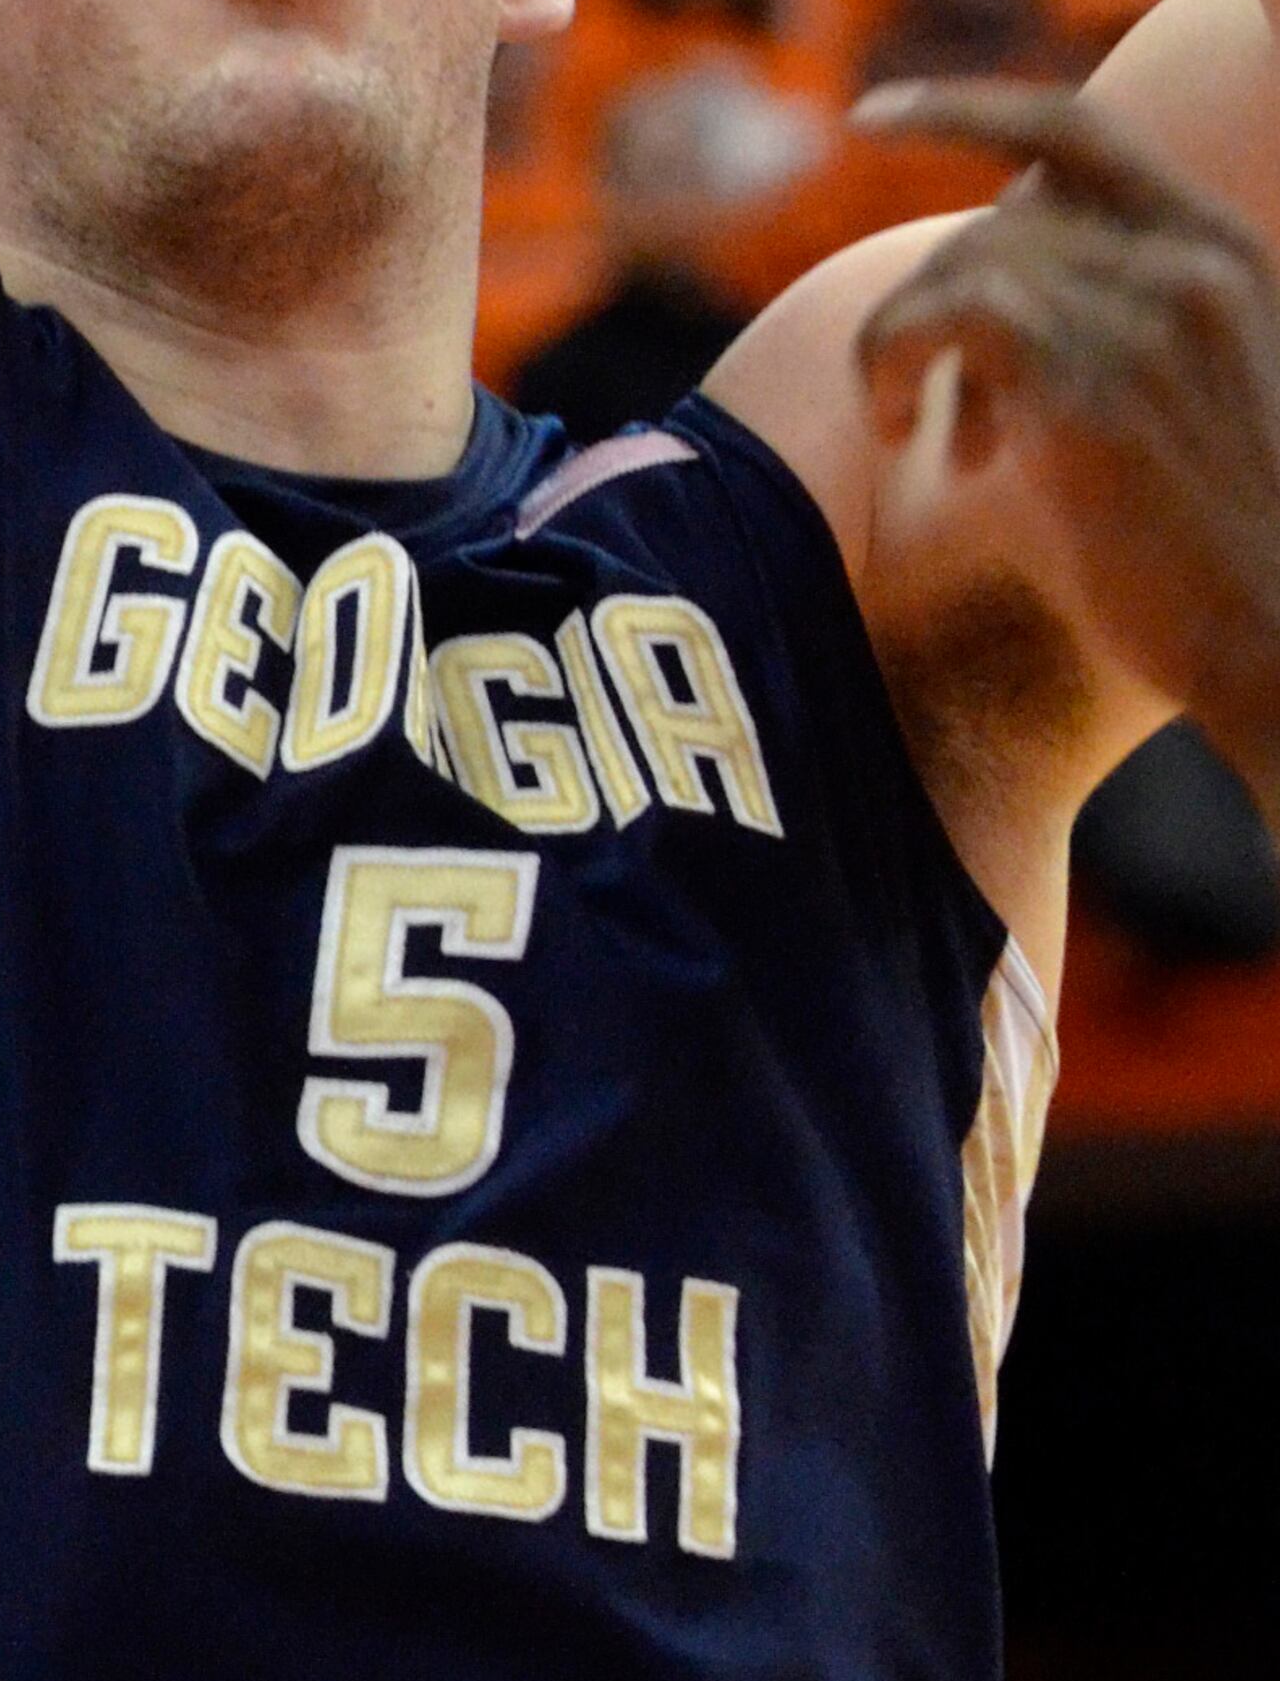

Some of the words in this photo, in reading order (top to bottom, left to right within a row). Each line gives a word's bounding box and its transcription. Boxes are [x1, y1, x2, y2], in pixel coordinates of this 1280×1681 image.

[26, 492, 785, 839] GEOGIA
[296, 844, 540, 1198] 5
[53, 1202, 740, 1560] TECH
